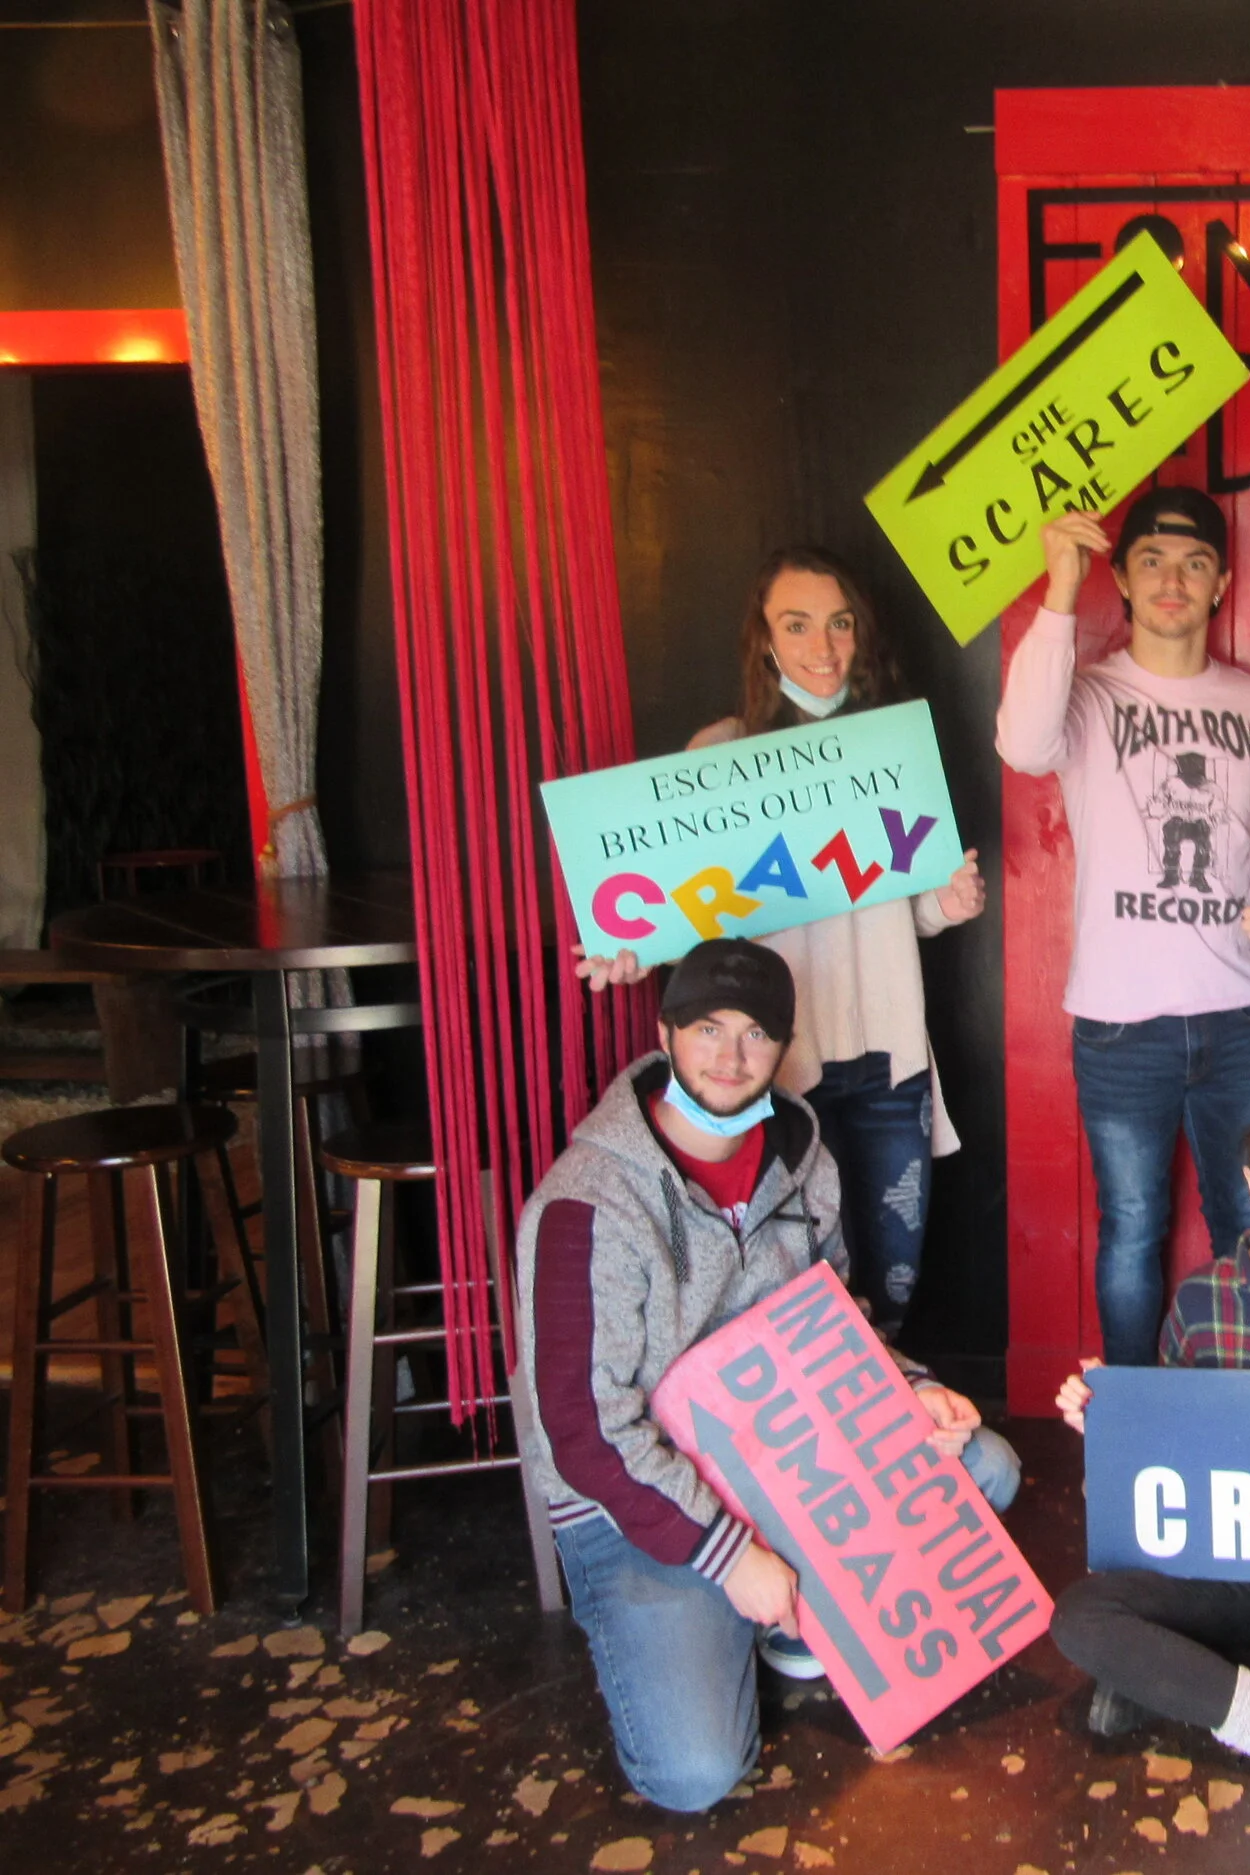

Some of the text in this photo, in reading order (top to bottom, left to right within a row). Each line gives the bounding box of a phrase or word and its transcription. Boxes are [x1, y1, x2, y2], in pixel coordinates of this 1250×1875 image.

[947, 339, 1196, 587] SCARES
[1011, 394, 1074, 464] SHE
[1062, 470, 1117, 513] ME
[649, 734, 844, 803] ESCAPING
[1113, 701, 1199, 774] DEATH
[599, 764, 904, 860] BRINGS OUT MY
[591, 807, 939, 940] CRAZY
[1114, 890, 1247, 926] RECORD
[717, 1343, 958, 1680] DUMBASS
[767, 1279, 1039, 1664] INTELLECTUAL
